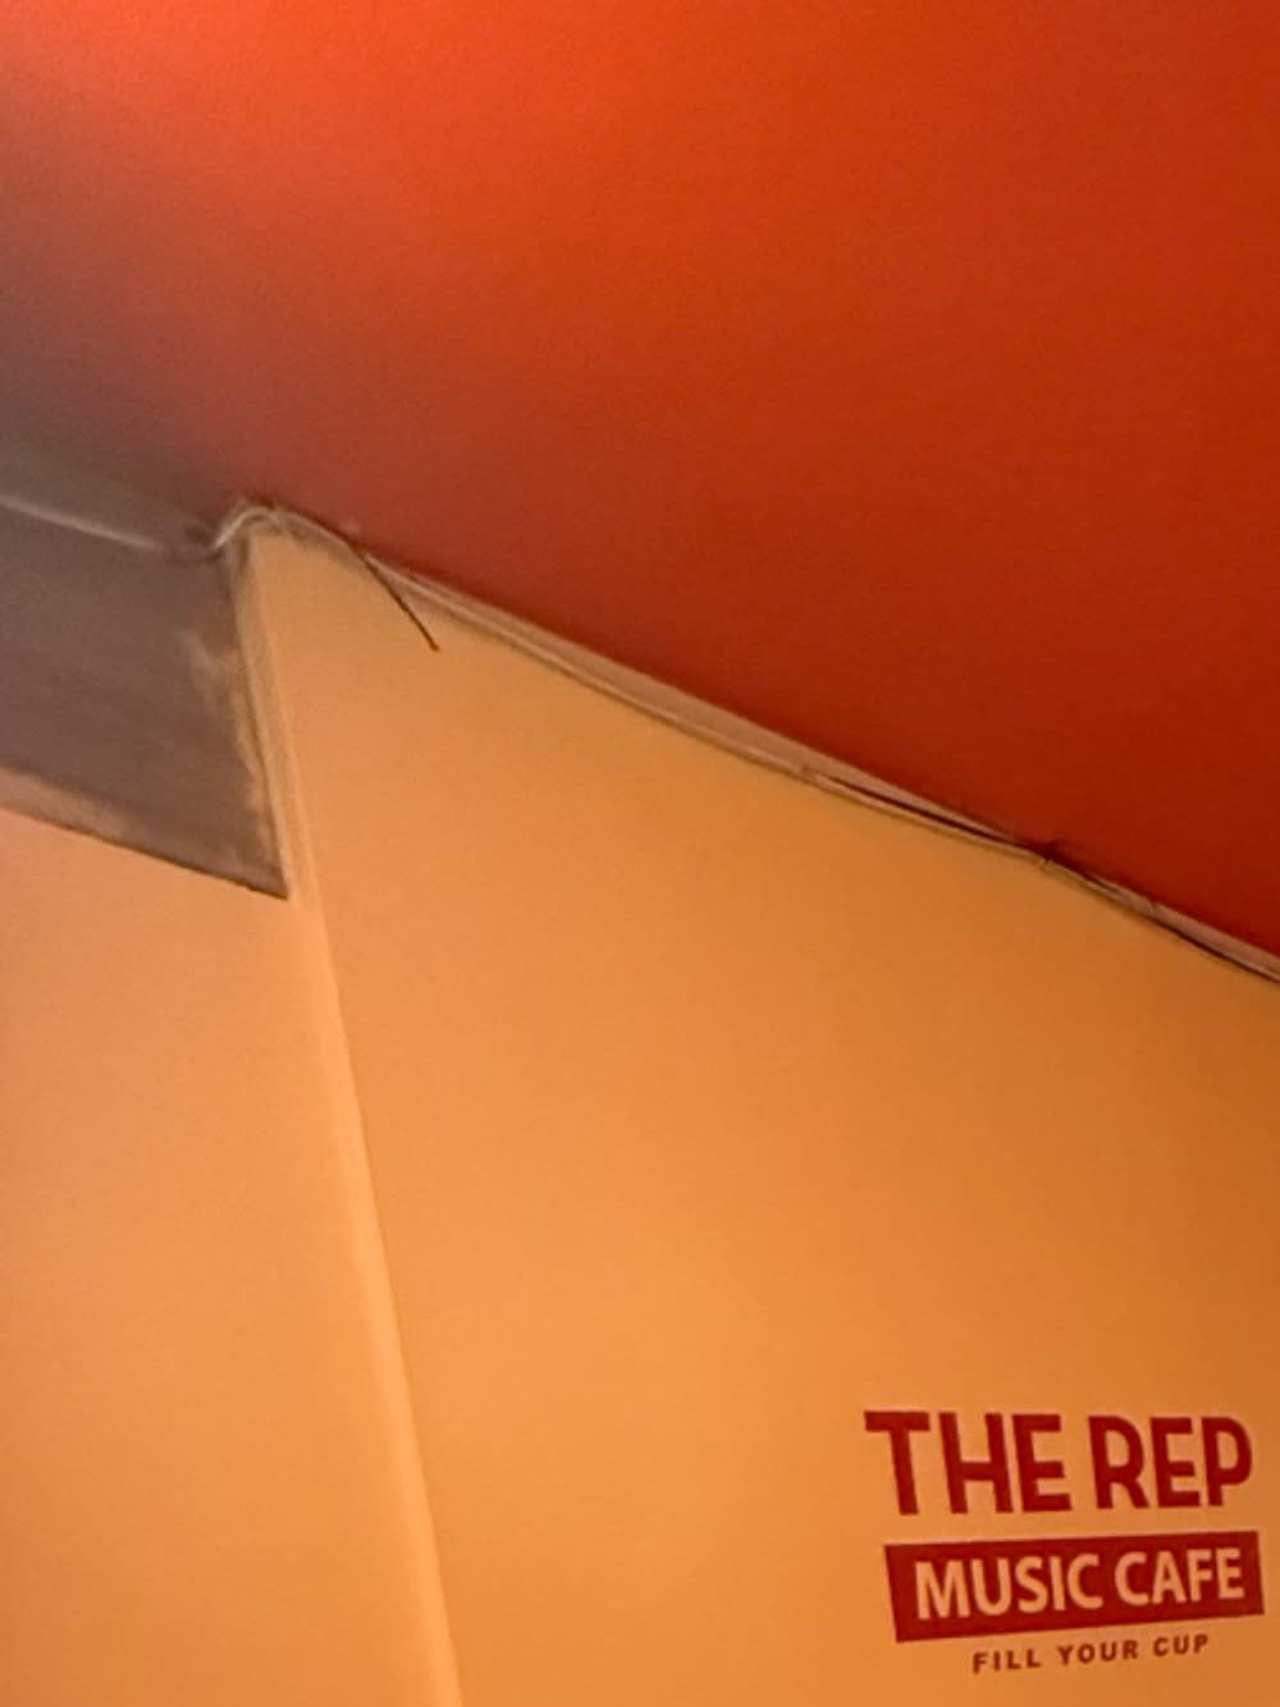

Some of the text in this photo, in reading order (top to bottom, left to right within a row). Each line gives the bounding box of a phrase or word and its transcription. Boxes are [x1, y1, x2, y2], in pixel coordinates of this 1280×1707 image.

[864, 1411, 1253, 1516] THE REP
[914, 1546, 1246, 1621] MUSIC CAFE
[972, 1633, 1209, 1675] FILL YOUR CUP
